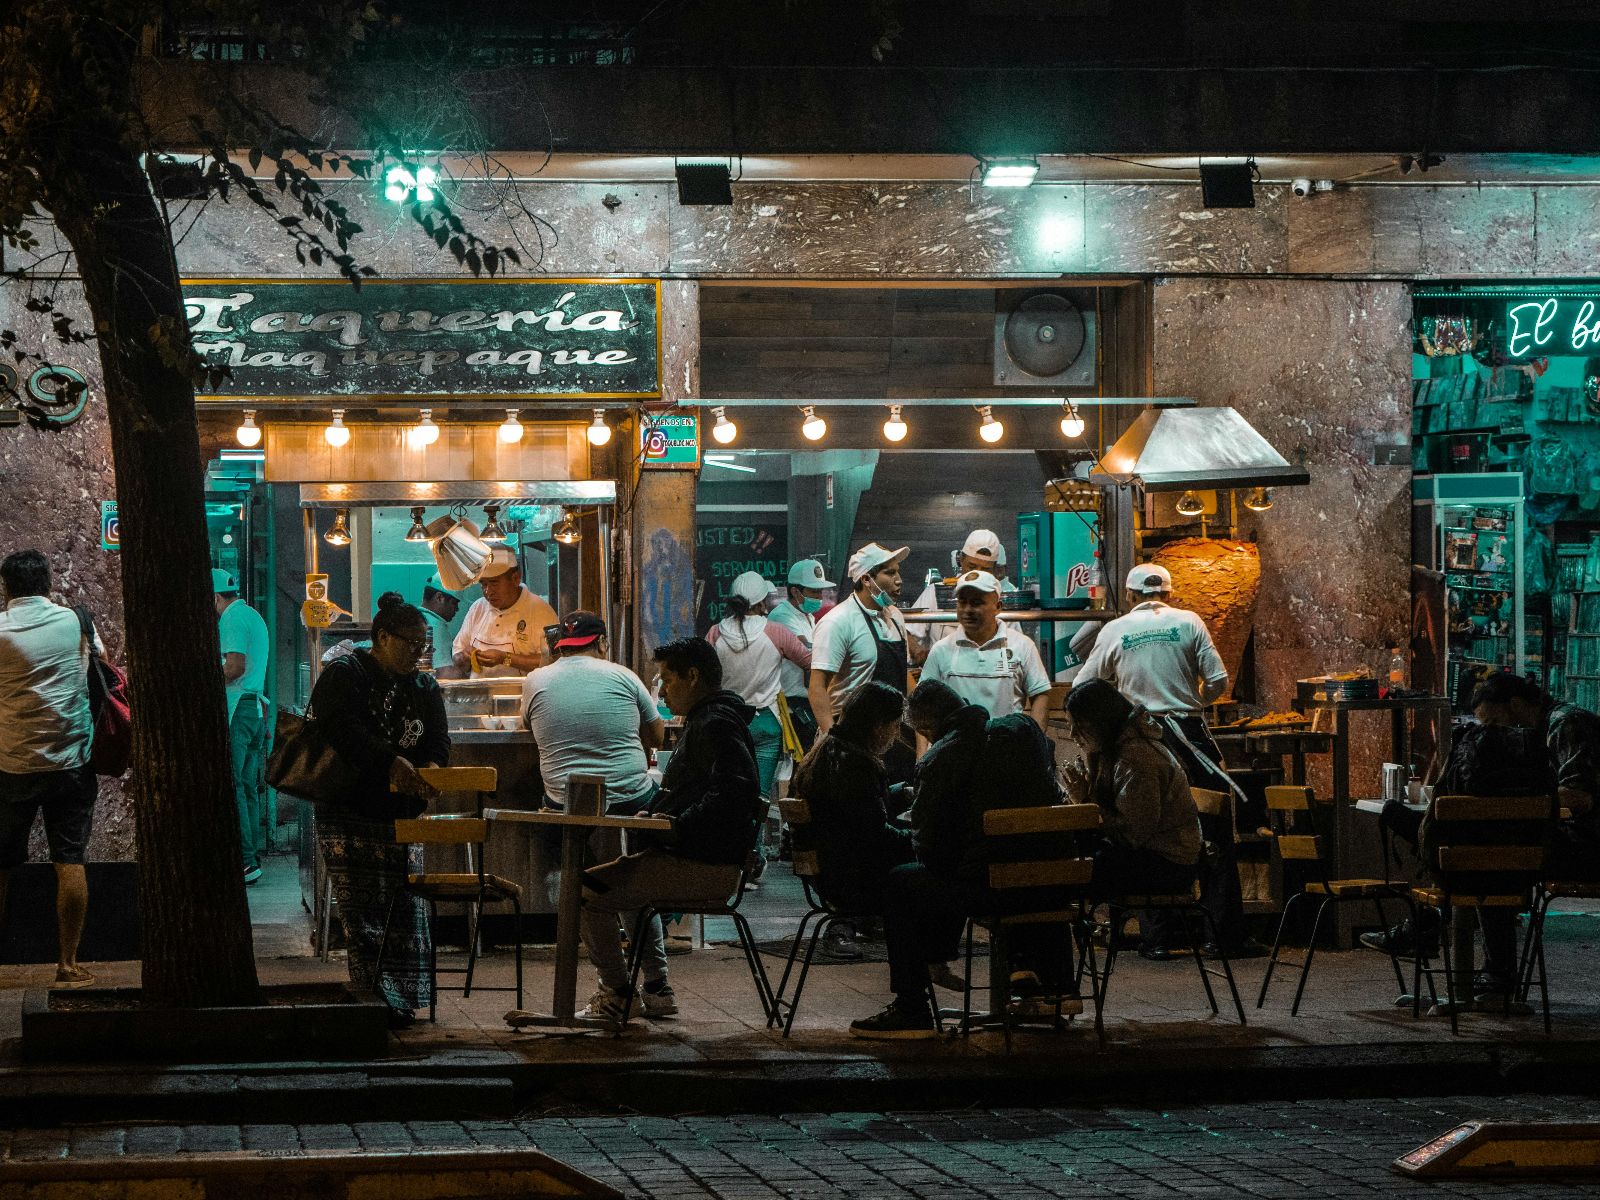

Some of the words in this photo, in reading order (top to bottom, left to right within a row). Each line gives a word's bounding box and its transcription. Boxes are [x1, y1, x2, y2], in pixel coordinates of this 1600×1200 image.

[184, 291, 640, 347] Taquería
[1509, 298, 1558, 357] El
[105, 504, 118, 512] SIG
[1066, 563, 1090, 598] Pe
